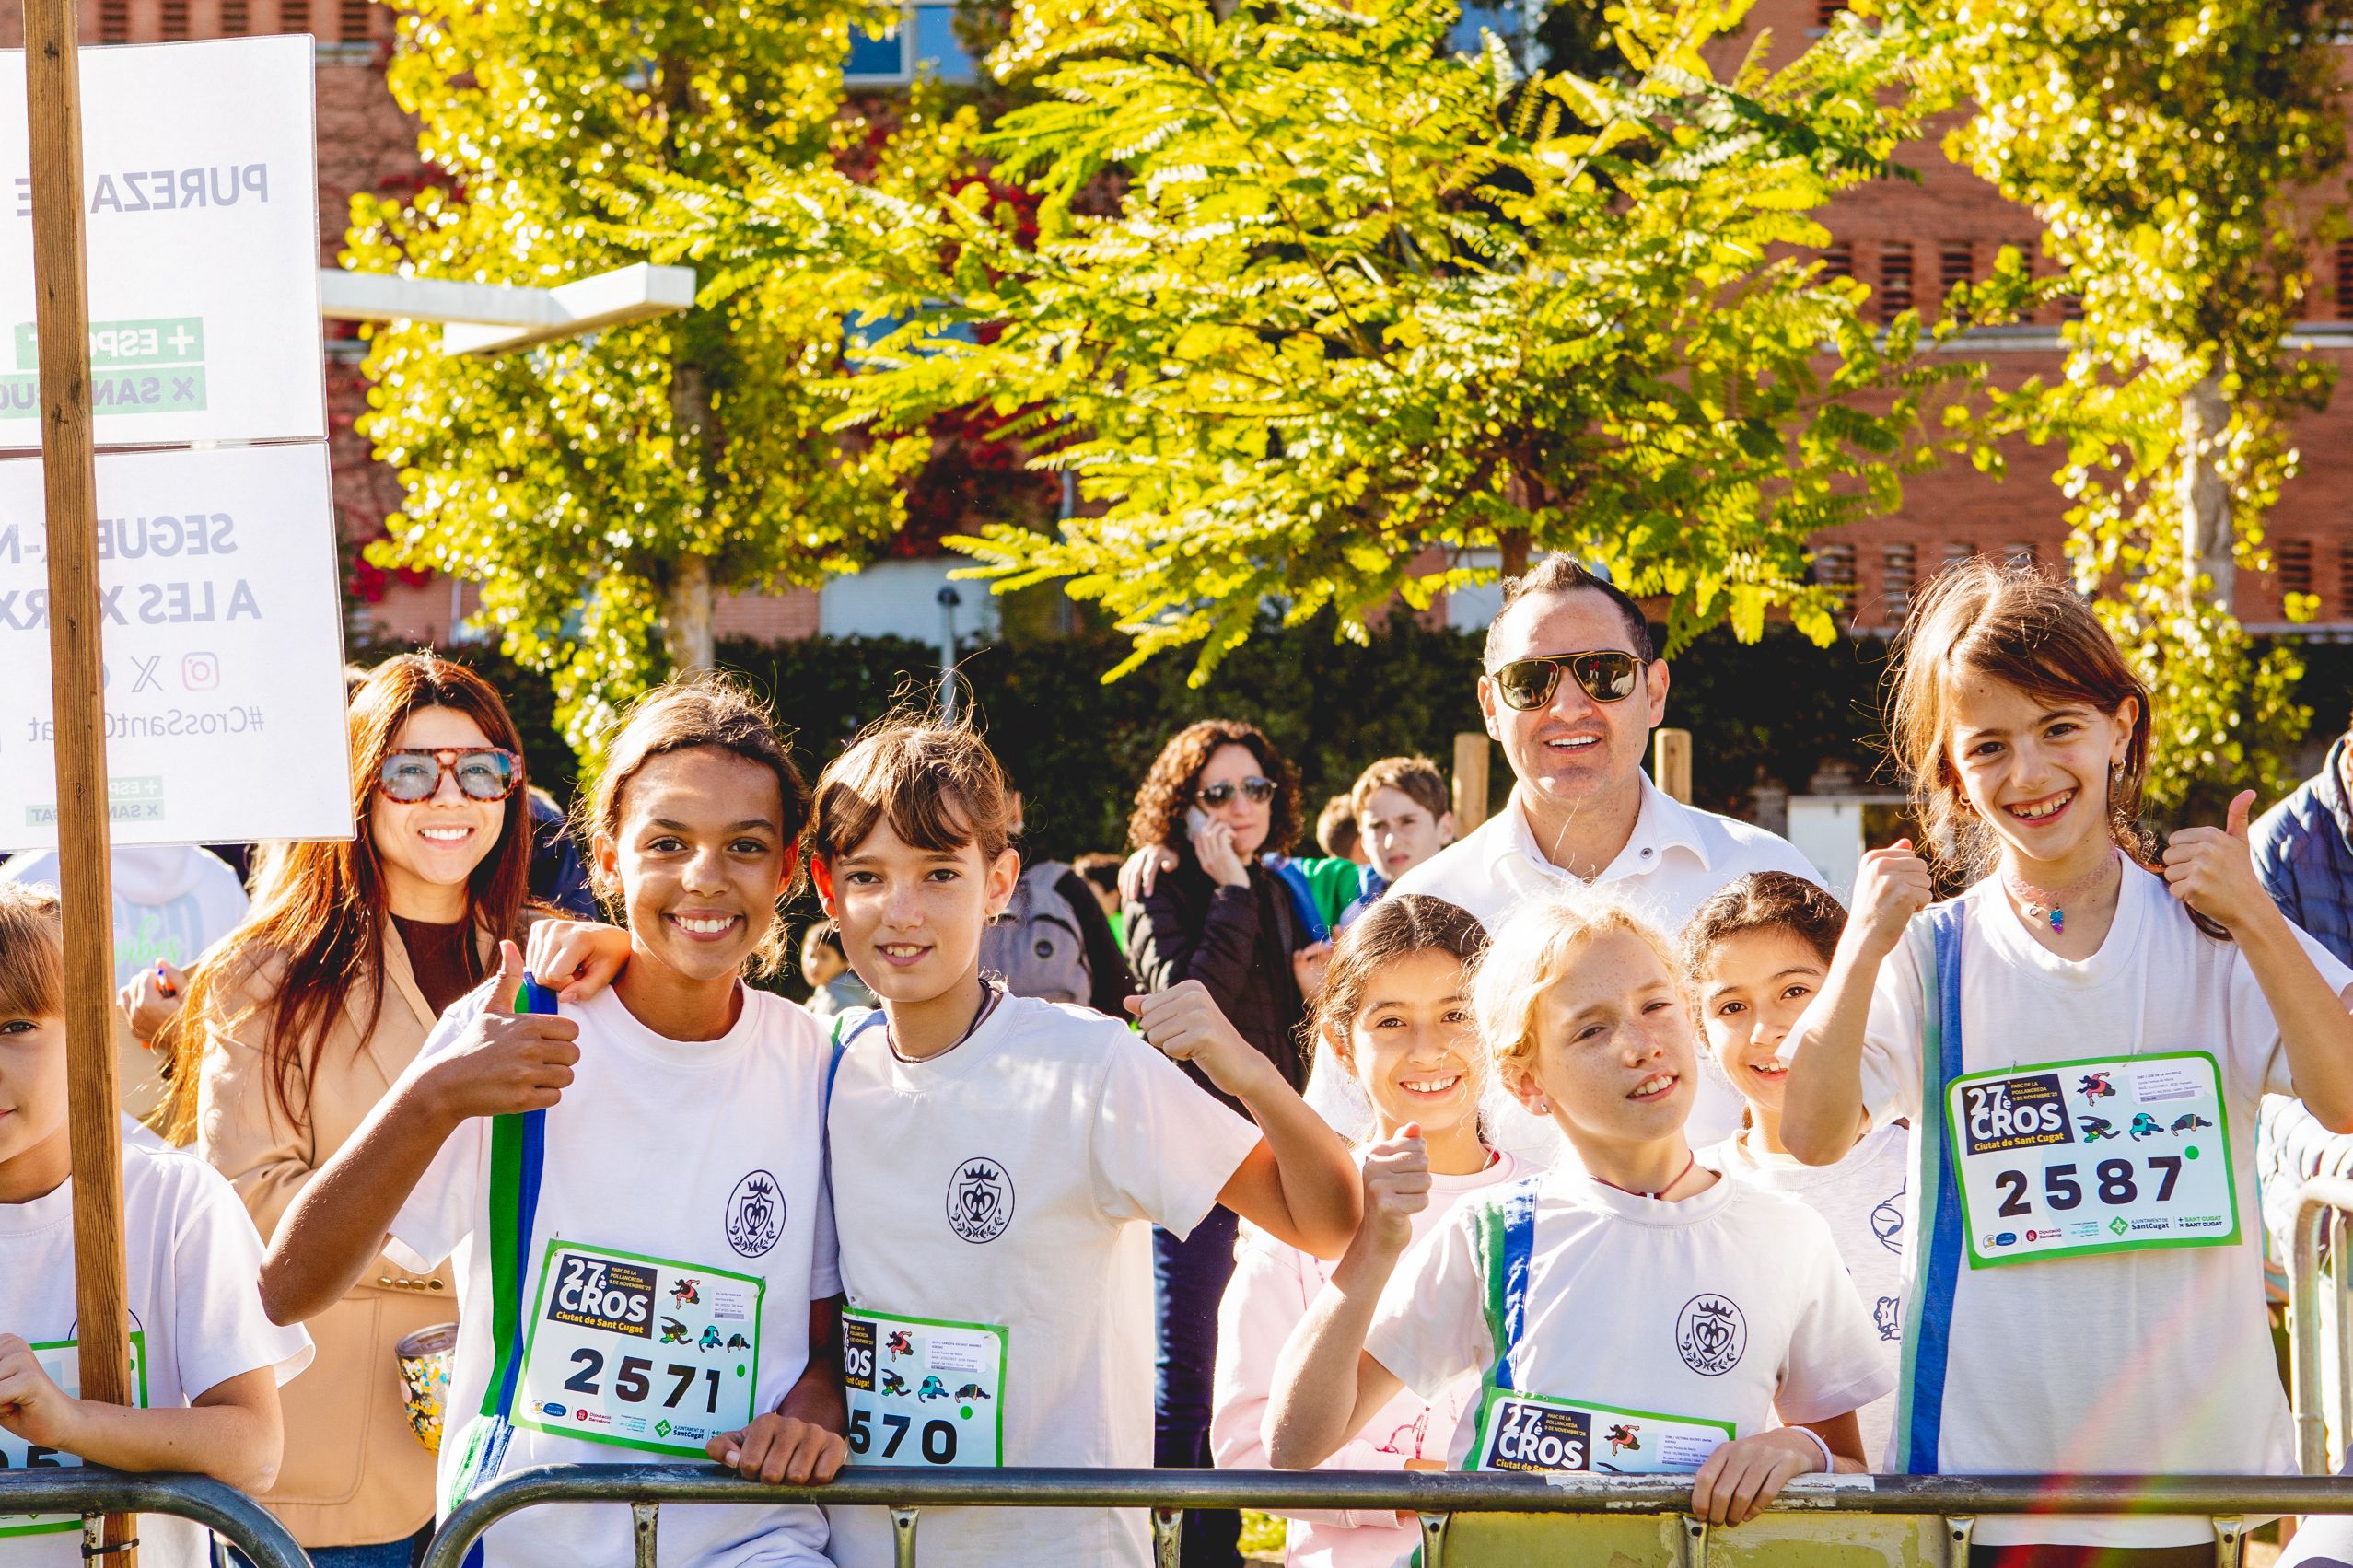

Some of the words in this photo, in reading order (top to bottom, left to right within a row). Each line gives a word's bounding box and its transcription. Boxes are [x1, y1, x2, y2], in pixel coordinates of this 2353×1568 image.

[1971, 1103, 2063, 1141] CROS
[1974, 1140, 2001, 1152] Ciutat
[2001, 1138, 2013, 1148] de
[2013, 1135, 2035, 1145] Sant
[2036, 1132, 2065, 1144] Cugat
[1995, 1156, 2182, 1218] 2587
[558, 1283, 649, 1324] CROS
[555, 1310, 584, 1324] Ciutat
[584, 1314, 596, 1325] de
[596, 1318, 617, 1330] Sant
[617, 1320, 645, 1335] Cugat
[563, 1347, 721, 1414] 2571
[855, 1376, 870, 1388] Cugat
[673, 1430, 705, 1439] SantCugat
[849, 1409, 958, 1465] 570
[1545, 1419, 1578, 1429] POLLANCREDA
[1496, 1458, 1521, 1470] Ciutat
[1521, 1463, 1532, 1471] de
[1498, 1431, 1584, 1469] CROS
